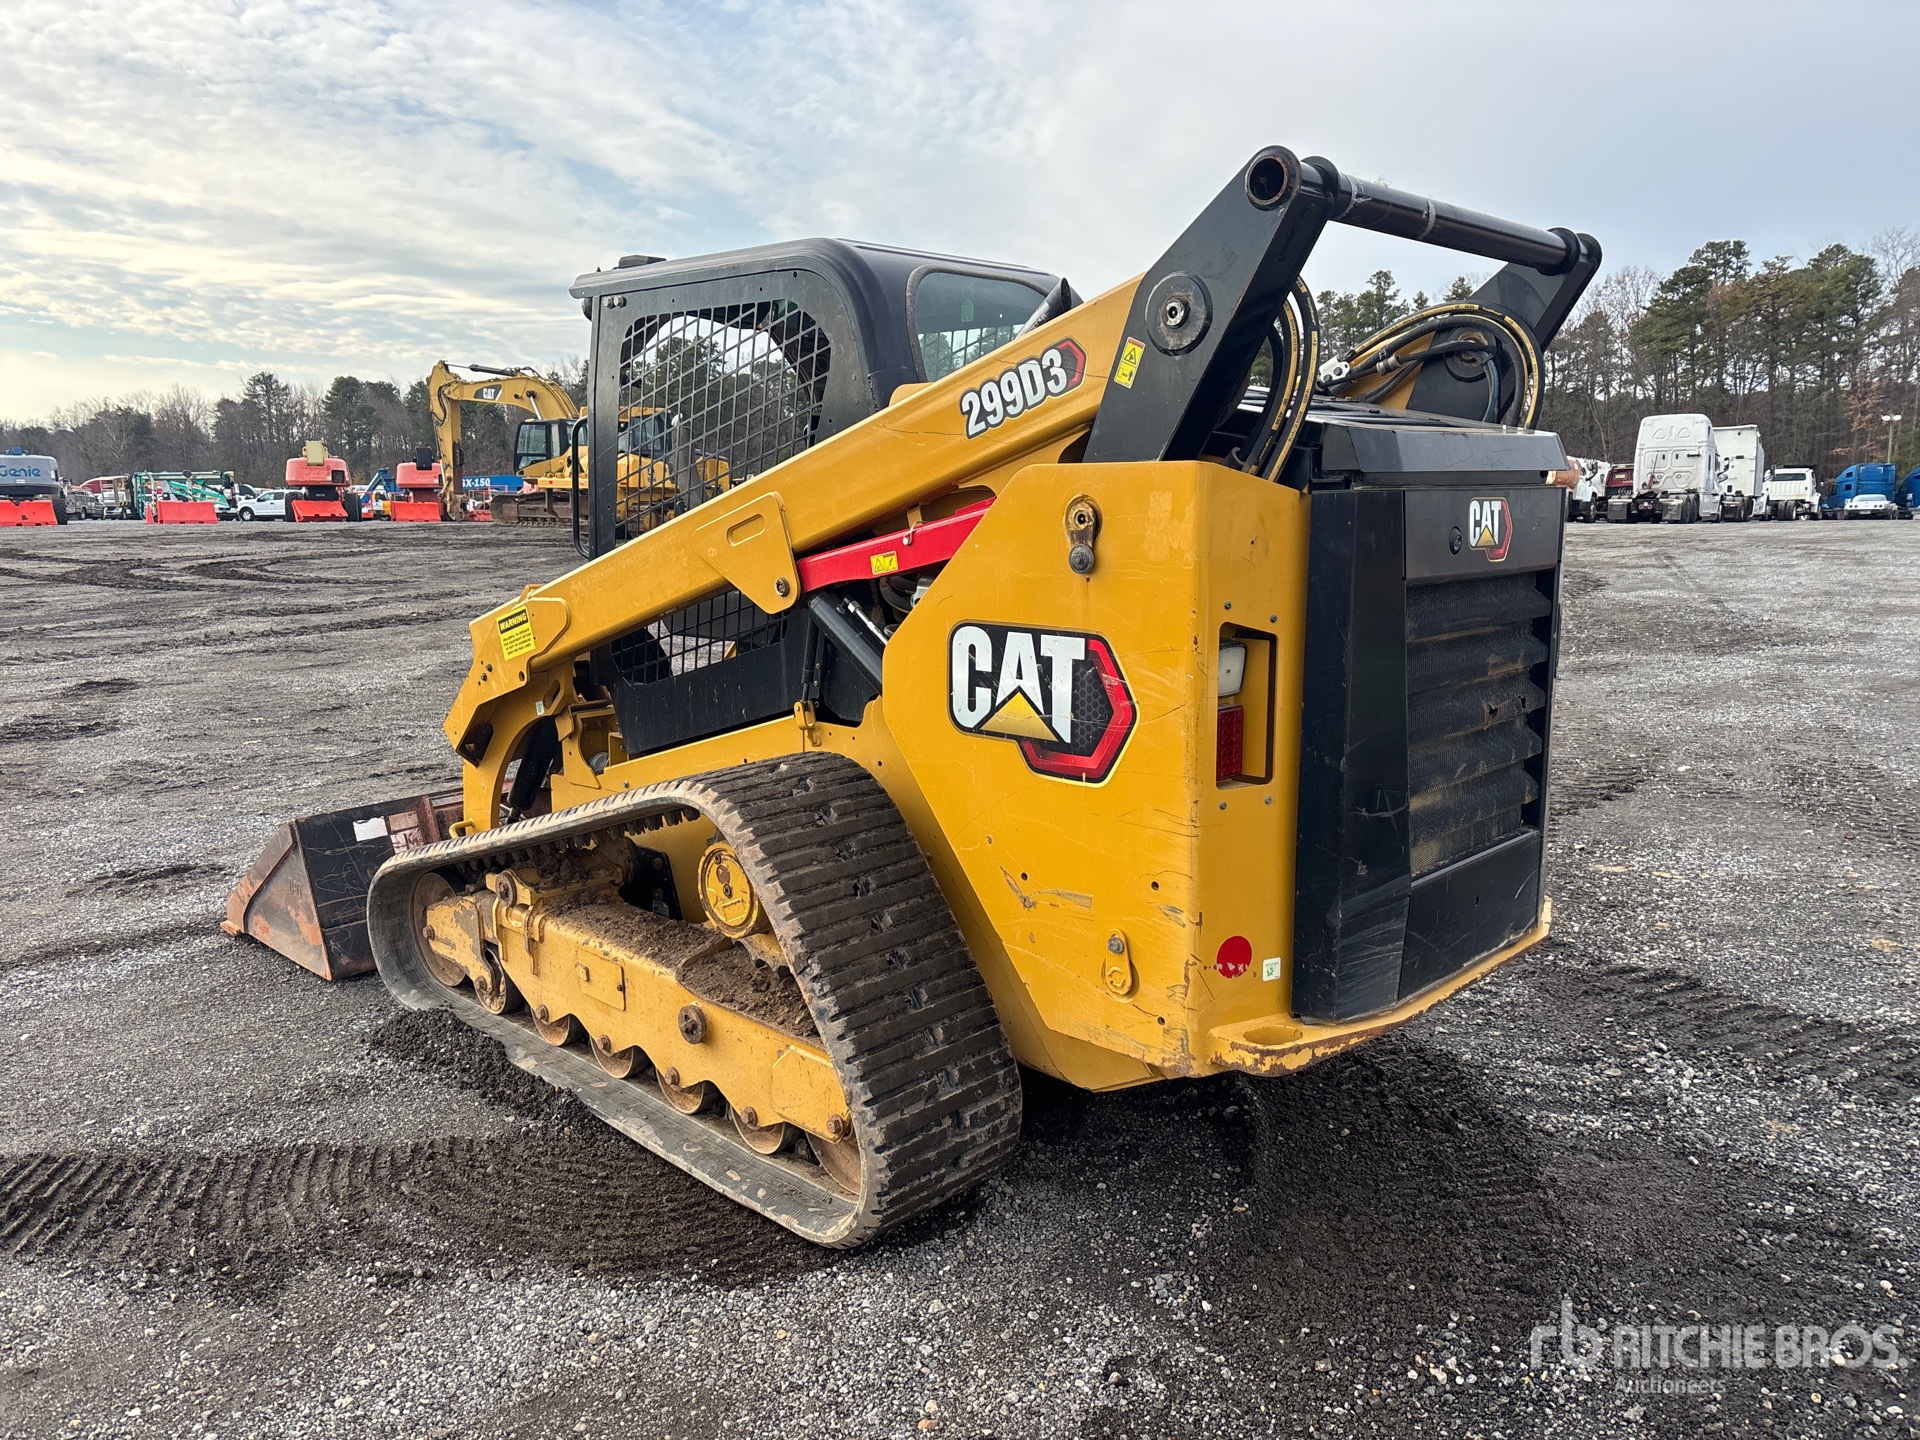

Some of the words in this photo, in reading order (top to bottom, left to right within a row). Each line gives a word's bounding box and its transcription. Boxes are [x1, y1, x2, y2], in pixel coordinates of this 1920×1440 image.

[482, 387, 496, 400] CAT
[961, 348, 1068, 437] 299D3
[0, 465, 41, 477] Genie
[1469, 499, 1502, 547] CAT
[499, 612, 527, 632] WARNING
[952, 625, 1086, 744] CAT
